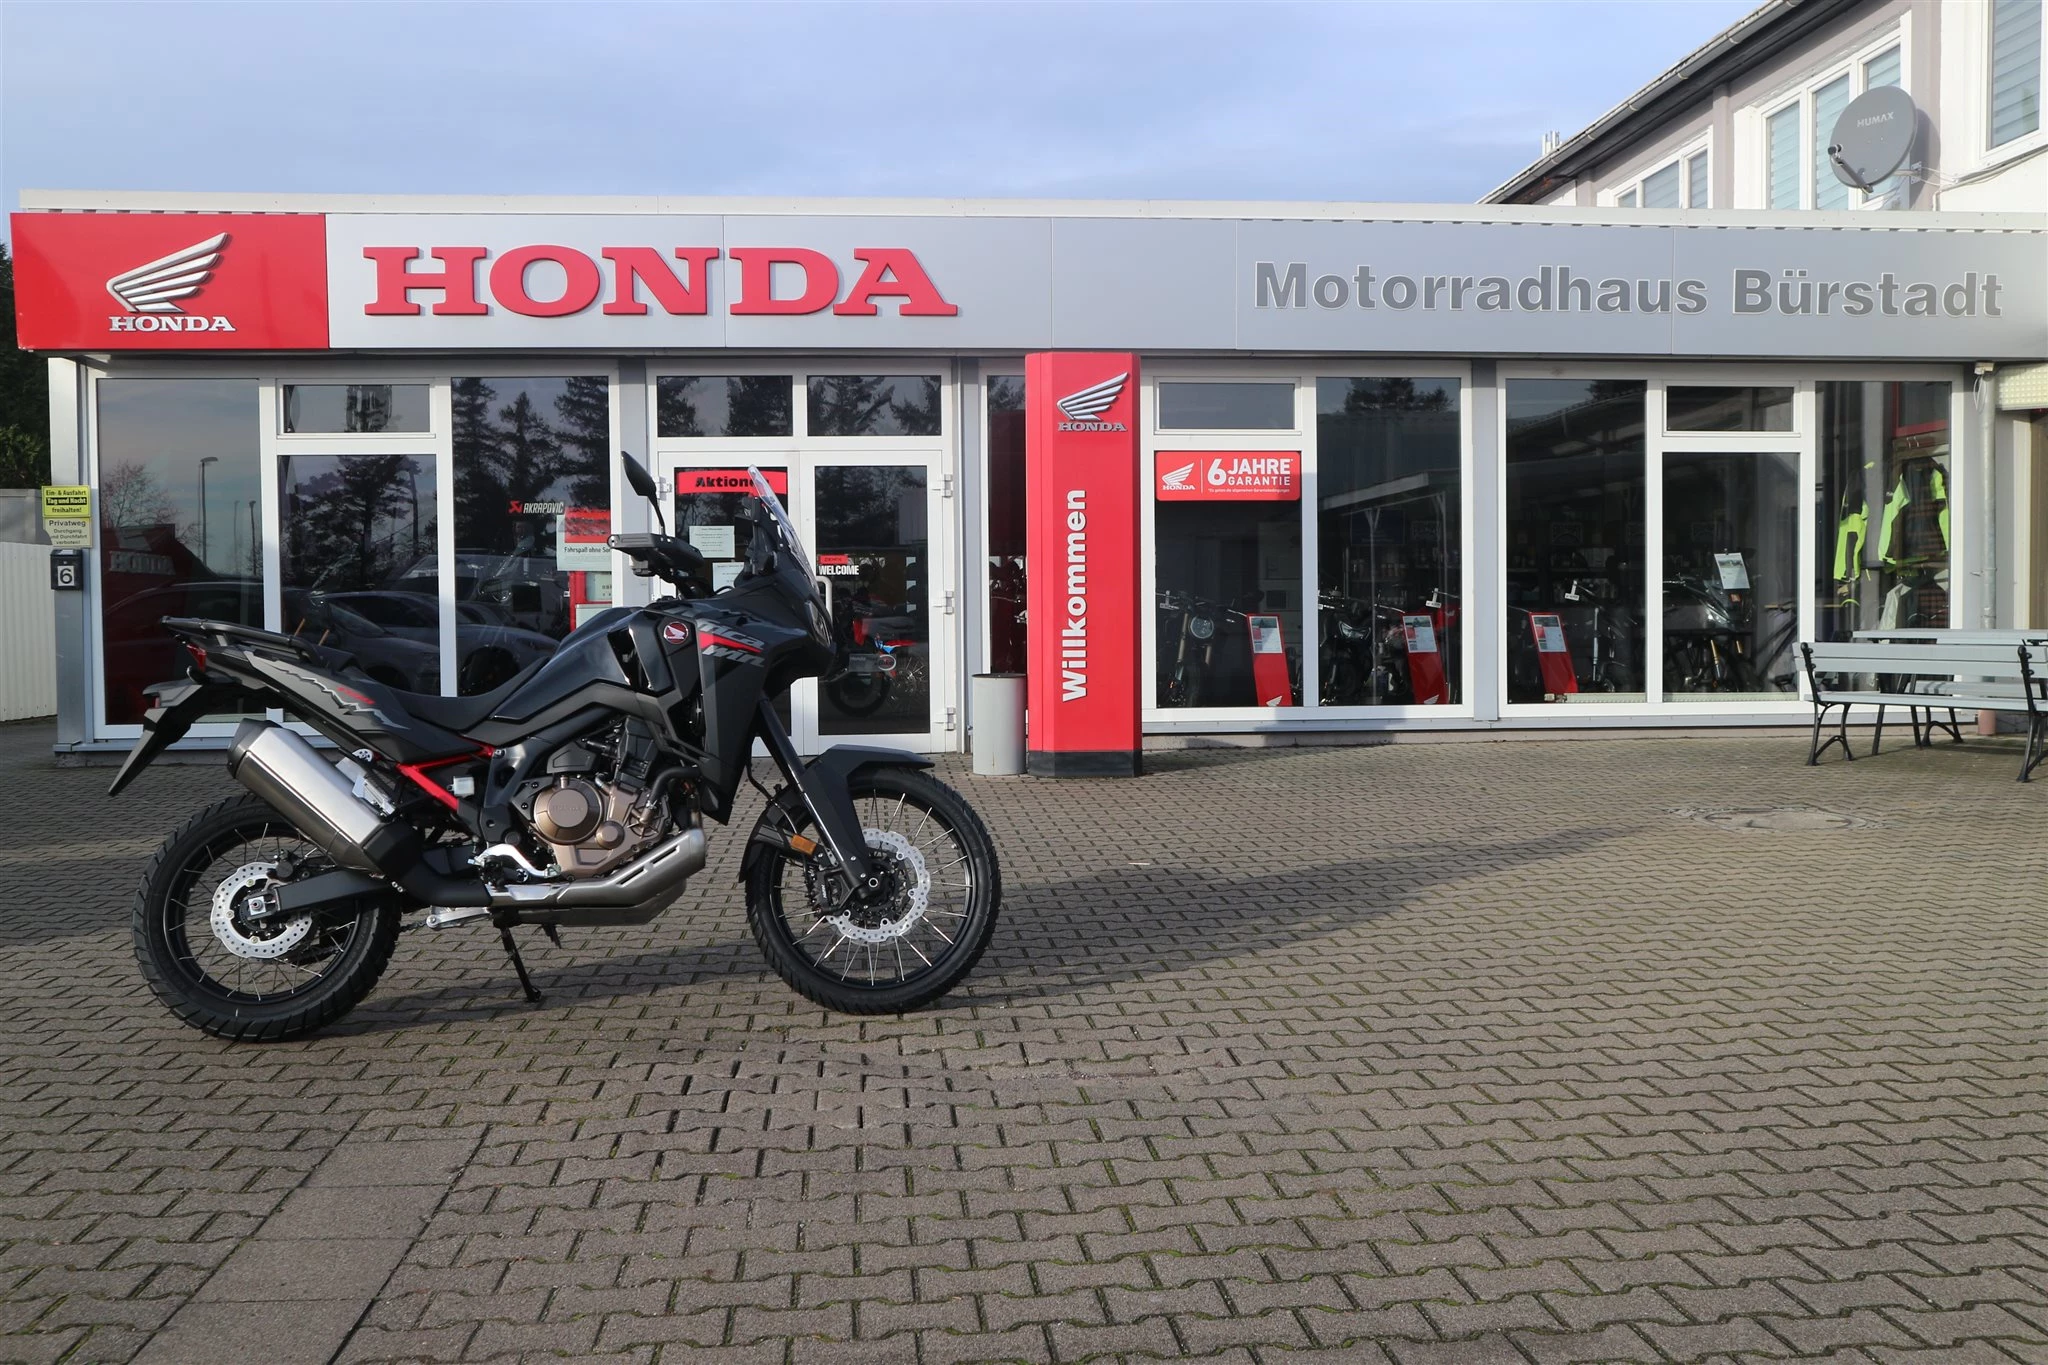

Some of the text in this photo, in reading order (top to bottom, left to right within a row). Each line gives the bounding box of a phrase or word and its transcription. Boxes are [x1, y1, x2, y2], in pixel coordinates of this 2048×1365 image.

[1856, 111, 1895, 127] HUMAX
[363, 245, 959, 316] HONDA
[1253, 261, 2004, 317] Motorradhaus Bürstadt
[109, 316, 236, 332] HONDA
[1058, 422, 1127, 432] HONDA
[1207, 458, 1227, 486] 6
[695, 477, 770, 487] Aktion
[1228, 476, 1291, 486] GARANTIE
[47, 497, 57, 505] Tag
[564, 546, 588, 554] Fahrspaß
[59, 568, 73, 584] 6
[818, 565, 860, 576] WELCOME
[1062, 490, 1087, 702] Willkommen
